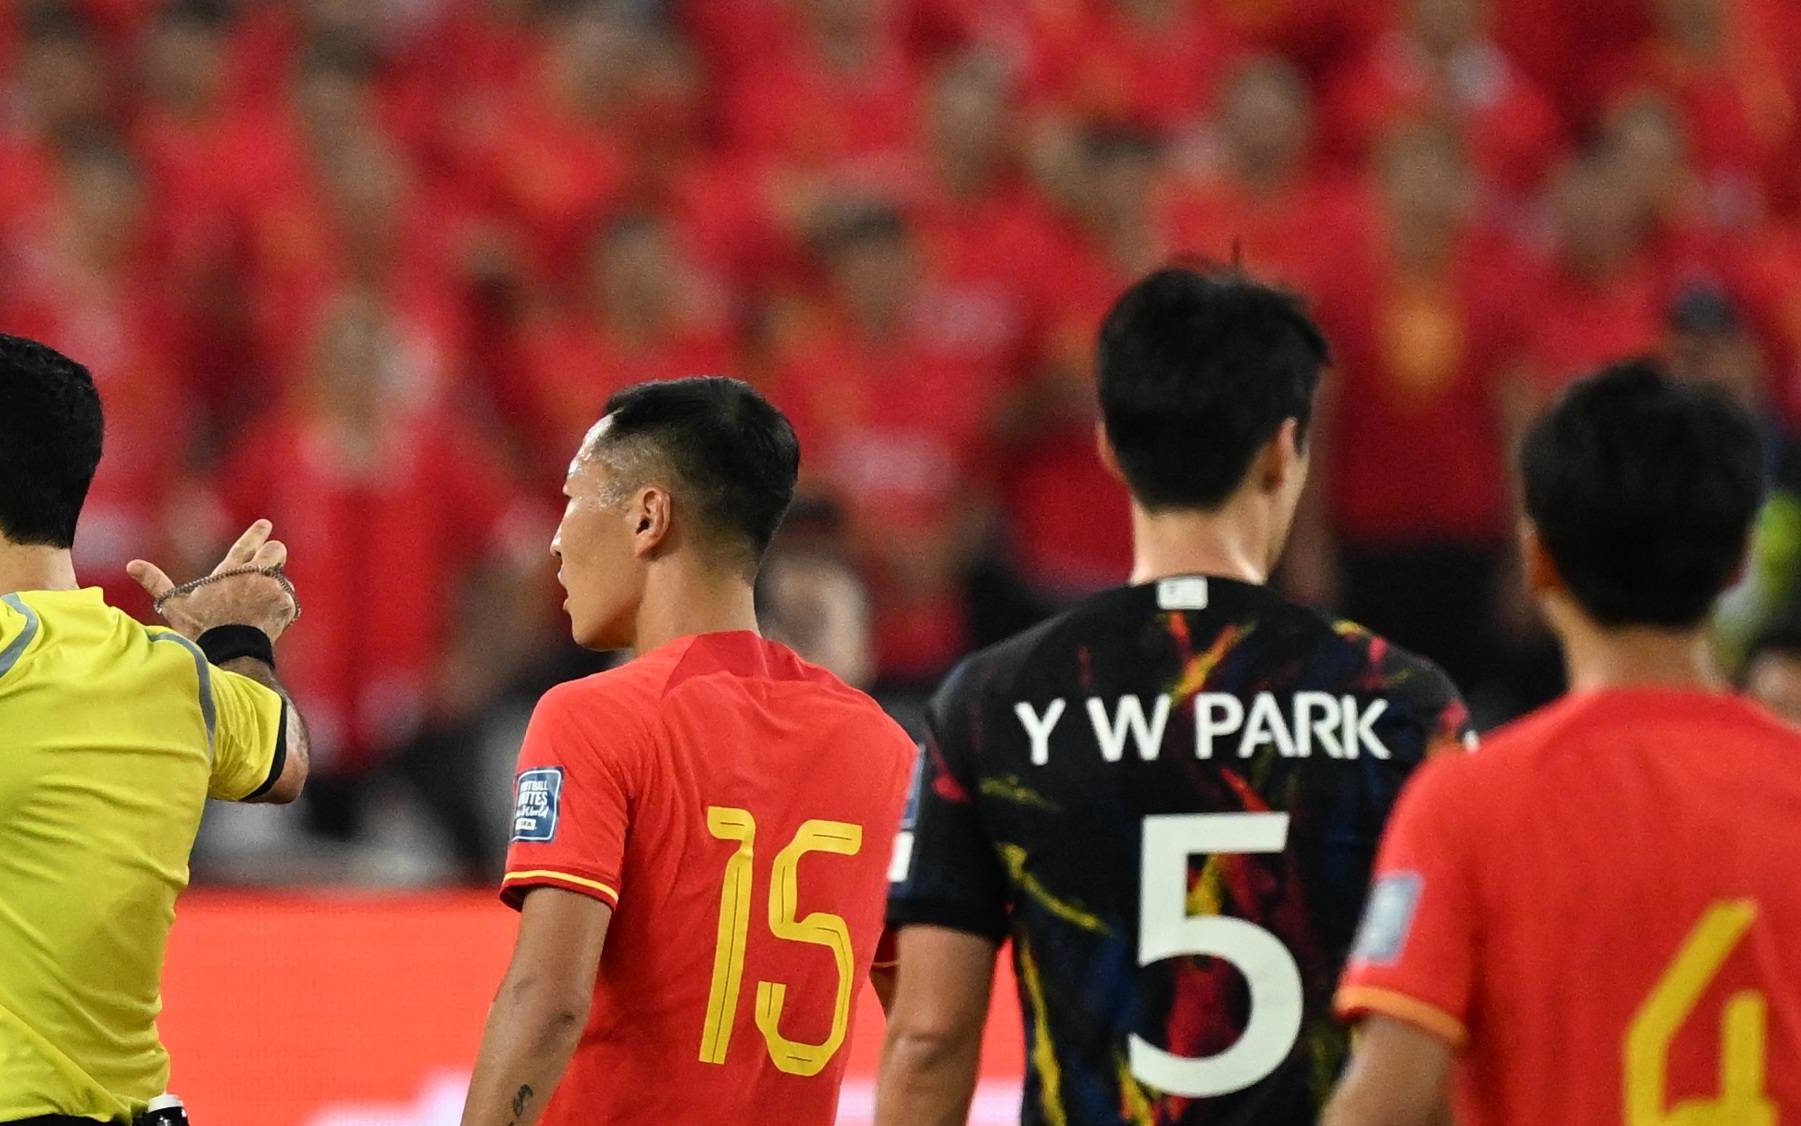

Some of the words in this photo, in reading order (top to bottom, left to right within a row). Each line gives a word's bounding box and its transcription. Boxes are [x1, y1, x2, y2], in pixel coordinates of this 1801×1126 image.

[1015, 697, 1067, 766] Y
[1086, 693, 1172, 762] W
[1194, 690, 1391, 760] PARK
[699, 805, 863, 1077] 15
[1128, 812, 1303, 1098] 5
